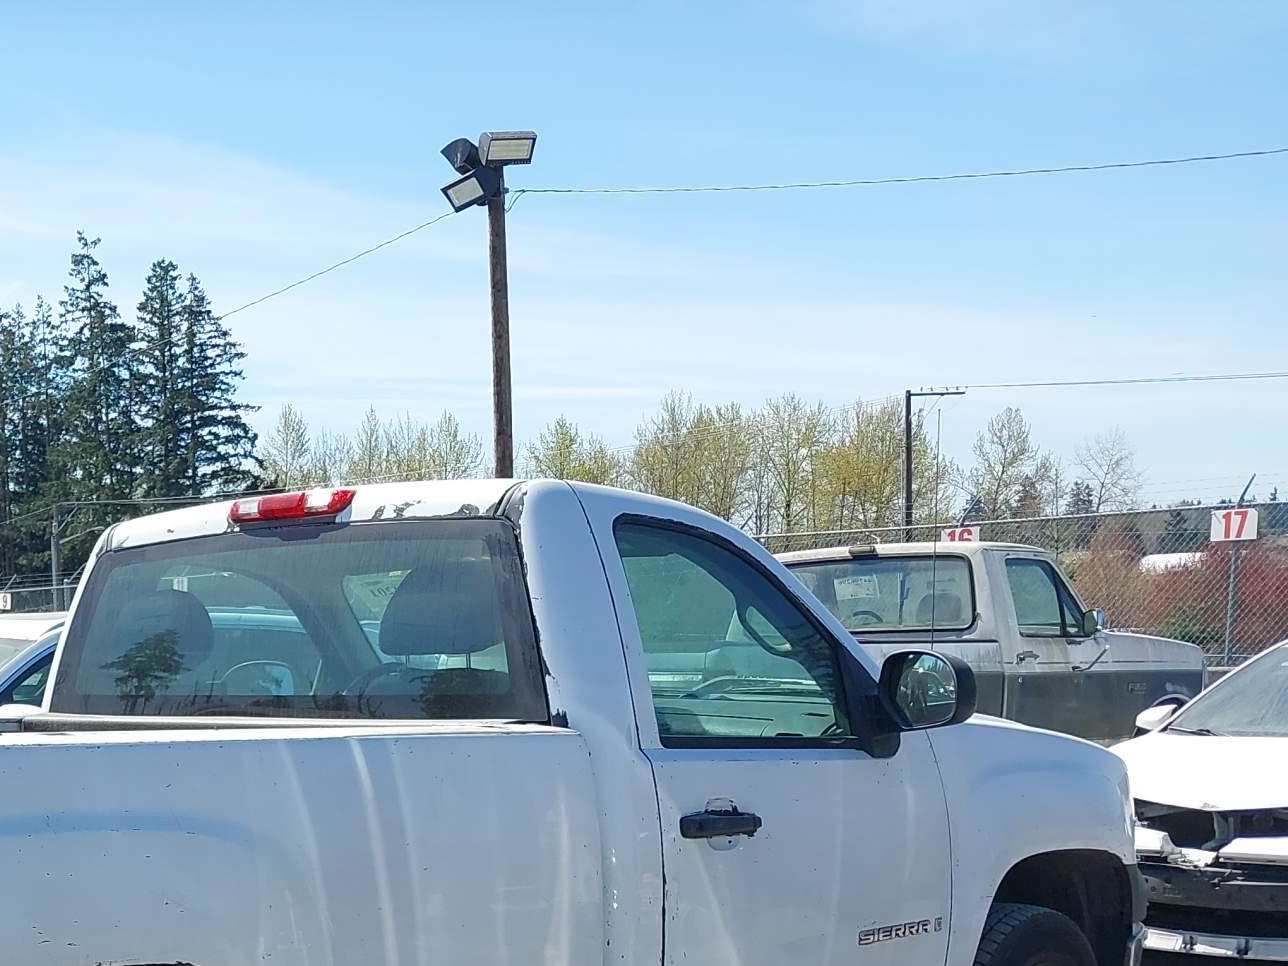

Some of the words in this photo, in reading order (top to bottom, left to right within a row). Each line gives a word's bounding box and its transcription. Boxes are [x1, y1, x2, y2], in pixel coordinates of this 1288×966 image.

[1223, 510, 1249, 539] 17
[2, 594, 8, 609] 9
[858, 919, 931, 946] SIERRA
